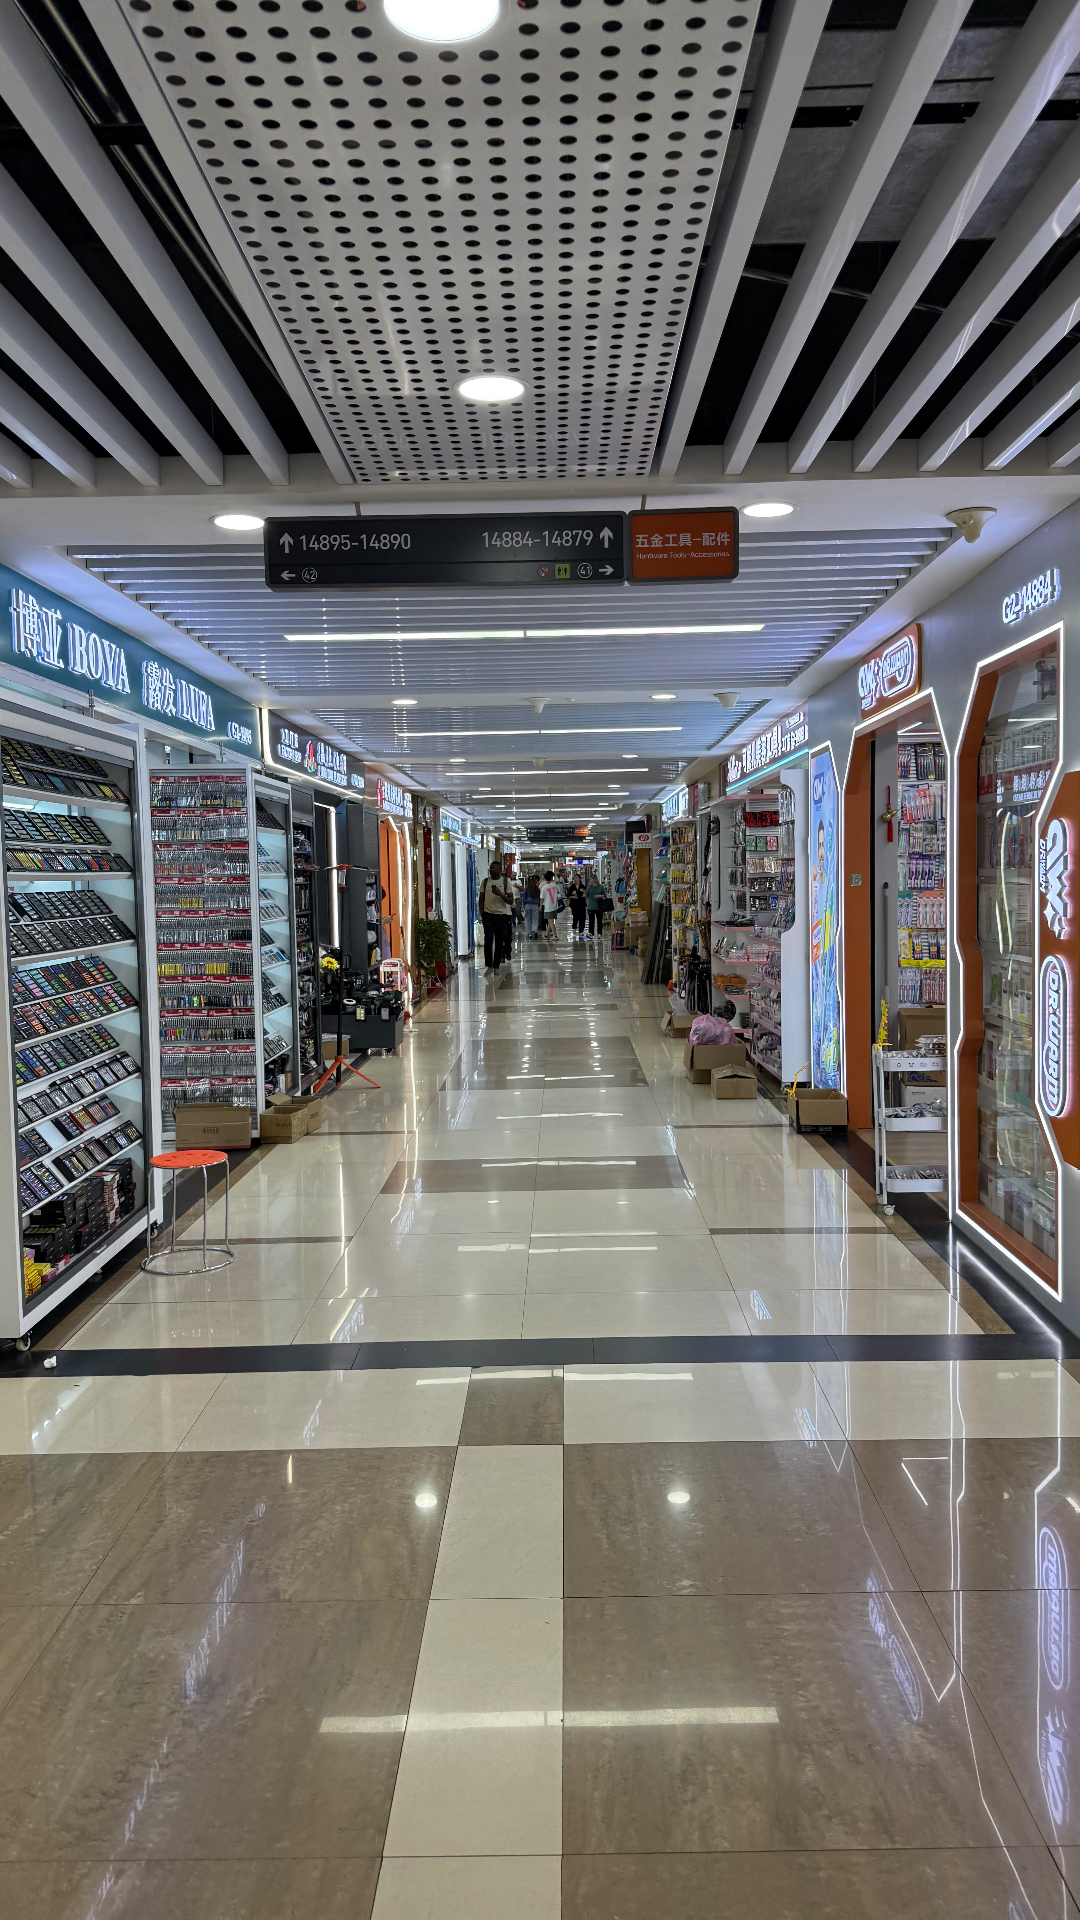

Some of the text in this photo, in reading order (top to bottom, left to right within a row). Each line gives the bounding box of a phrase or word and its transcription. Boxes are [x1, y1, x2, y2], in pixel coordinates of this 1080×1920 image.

[298, 533, 412, 551] 14895-14890
[481, 530, 593, 548] 14884-14879
[636, 550, 730, 560] Hardware Tools-Accessories
[303, 568, 316, 582] 42
[578, 563, 591, 577] 41
[1002, 570, 1056, 624] G2-14884
[9, 588, 64, 669] 博亚
[67, 623, 130, 694] BOYA
[177, 680, 215, 731] LUFA
[1042, 970, 1061, 1104] DR.WARM
